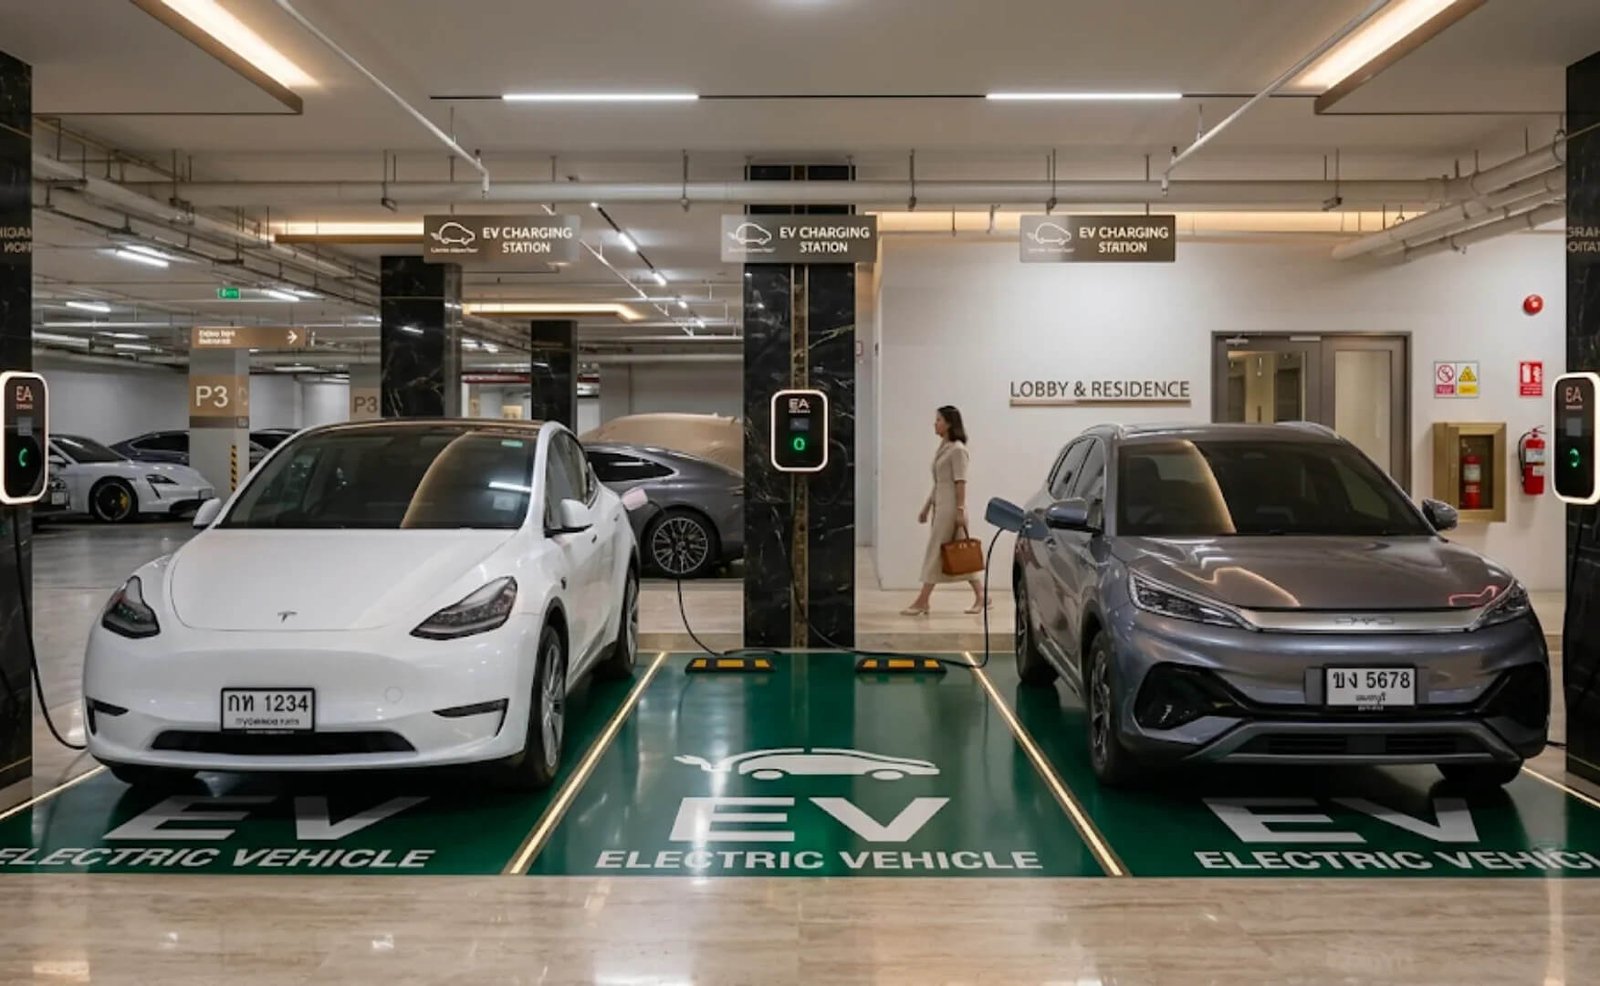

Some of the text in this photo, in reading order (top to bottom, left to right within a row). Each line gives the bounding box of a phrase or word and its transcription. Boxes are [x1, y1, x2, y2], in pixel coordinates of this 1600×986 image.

[482, 227, 573, 239] EV CHARGING
[779, 226, 870, 239] EV CHARGING
[1079, 226, 1169, 239] EV CHARGING
[502, 242, 551, 253] STATION
[800, 241, 849, 253] STATION
[1098, 241, 1148, 253] STATION
[16, 385, 33, 401] EA
[195, 385, 229, 408] P3
[1010, 381, 1190, 398] LOBBY & RESIDENCE
[354, 396, 378, 413] P3
[788, 398, 810, 409] EA
[1366, 671, 1411, 689] 5678
[265, 694, 308, 712] 1234
[102, 796, 430, 840] EV
[669, 797, 950, 842] EV
[1202, 798, 1480, 843] EV
[0, 848, 436, 868] ELECTRIC VEHICLE
[594, 851, 1043, 869] ELECTRIC VEHICLE
[1194, 851, 1433, 870] ELECTRIC
